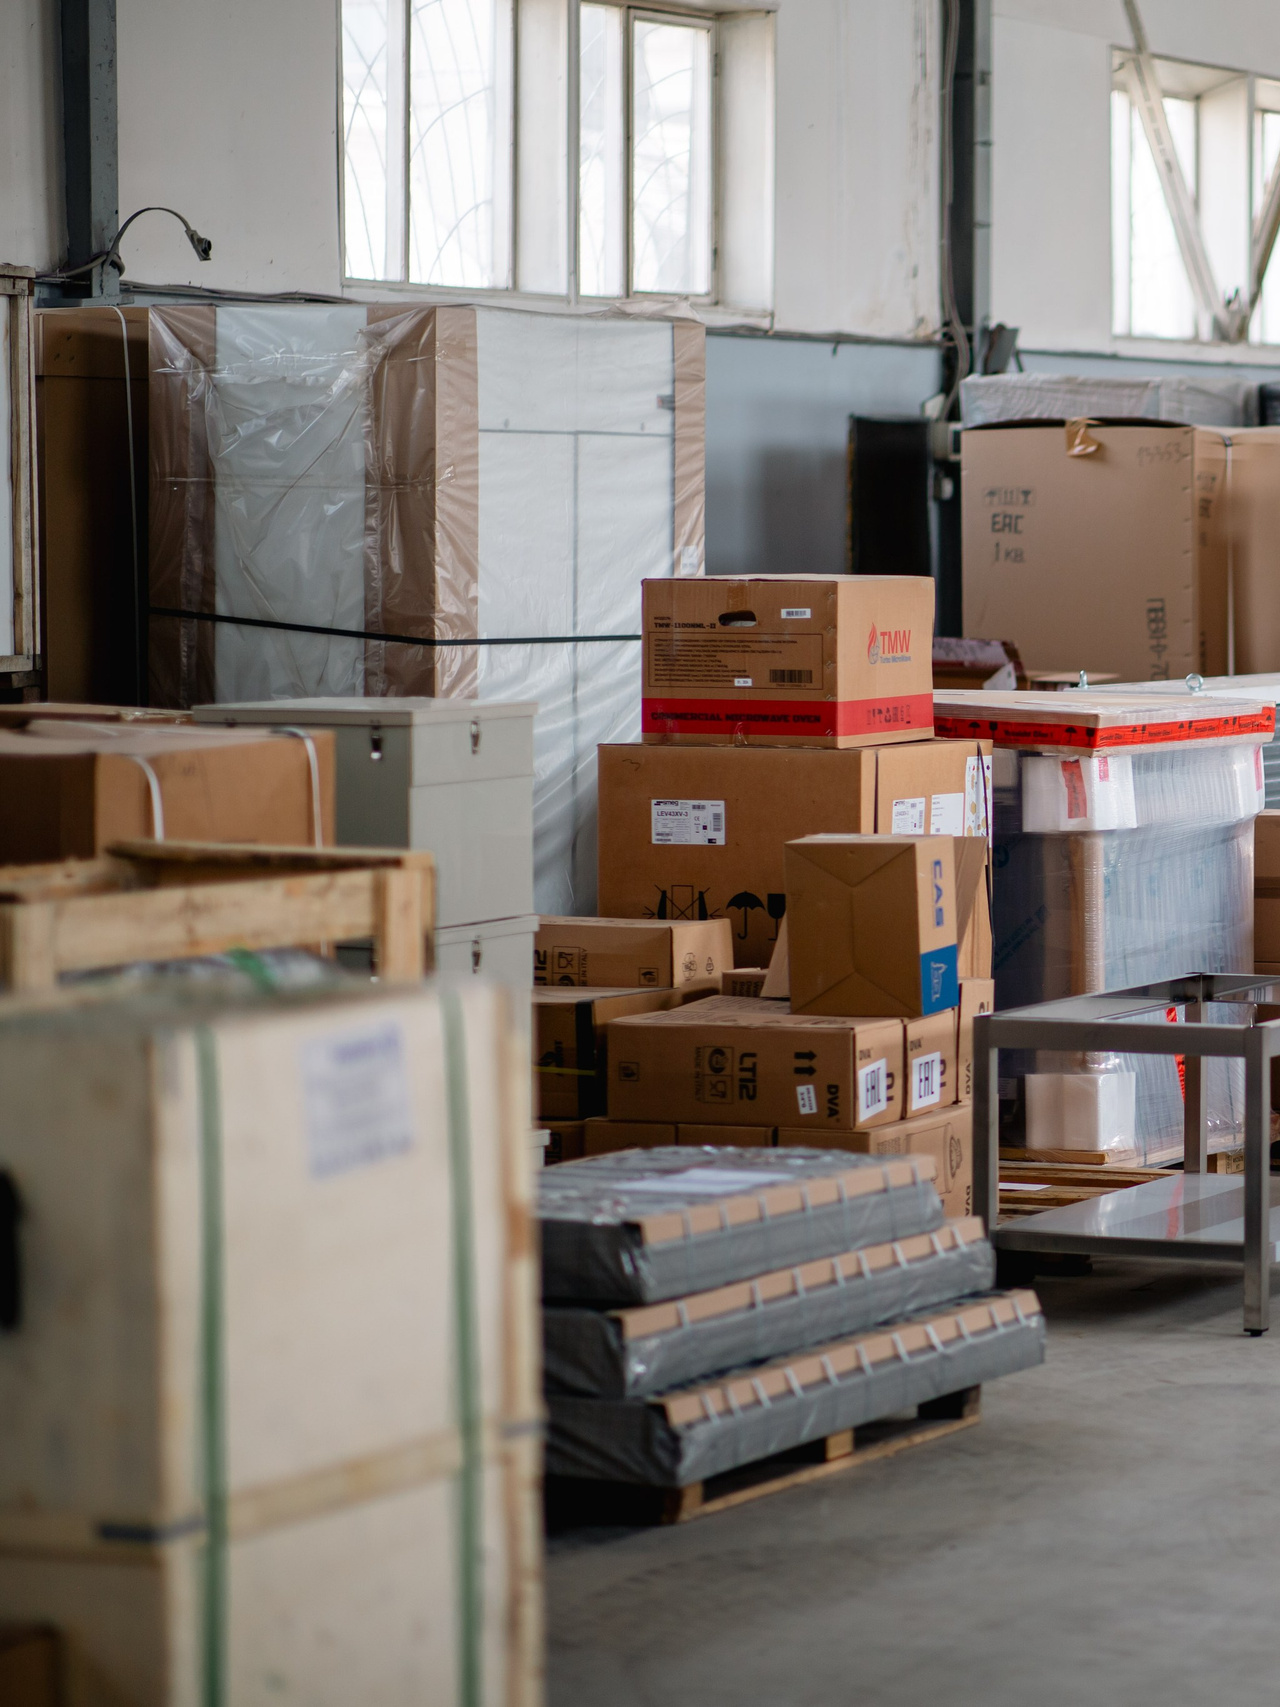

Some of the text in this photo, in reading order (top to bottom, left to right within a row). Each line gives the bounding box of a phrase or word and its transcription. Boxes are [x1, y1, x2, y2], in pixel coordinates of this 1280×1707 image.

[880, 630, 911, 654] TMW
[651, 711, 821, 724] COMMERCIAL MICROWAVE OVEN
